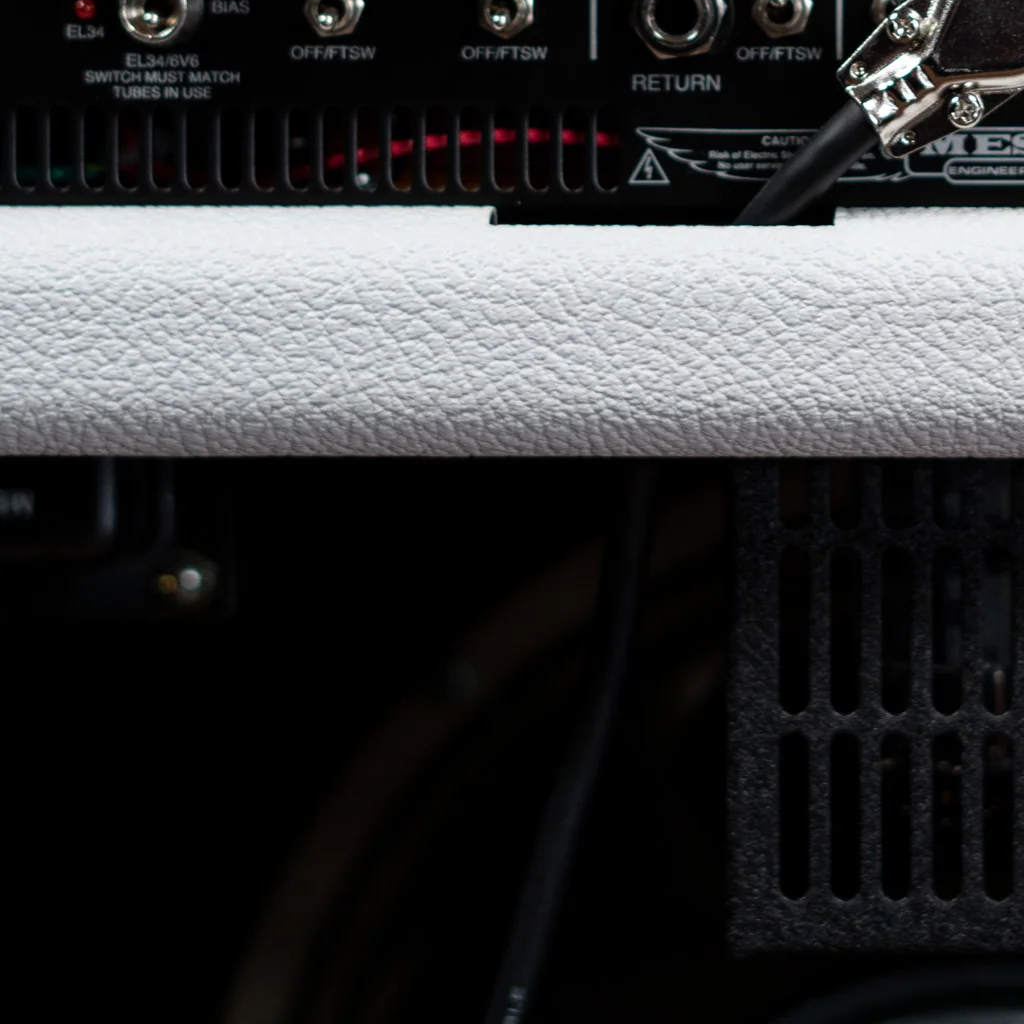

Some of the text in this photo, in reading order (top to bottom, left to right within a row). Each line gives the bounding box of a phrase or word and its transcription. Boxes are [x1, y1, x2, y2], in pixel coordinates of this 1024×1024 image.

[210, 0, 250, 14] BIAS
[64, 23, 105, 40] EL34
[124, 52, 200, 69] EL34/6V6
[290, 44, 376, 61] OFF/FTSW
[460, 45, 548, 61] OFF/FTSW
[735, 46, 822, 61] OFF/FTSW
[84, 69, 241, 84] SWITCH MUST MATCH
[631, 73, 721, 93] RETURN
[112, 85, 211, 100] TUBES IN USE
